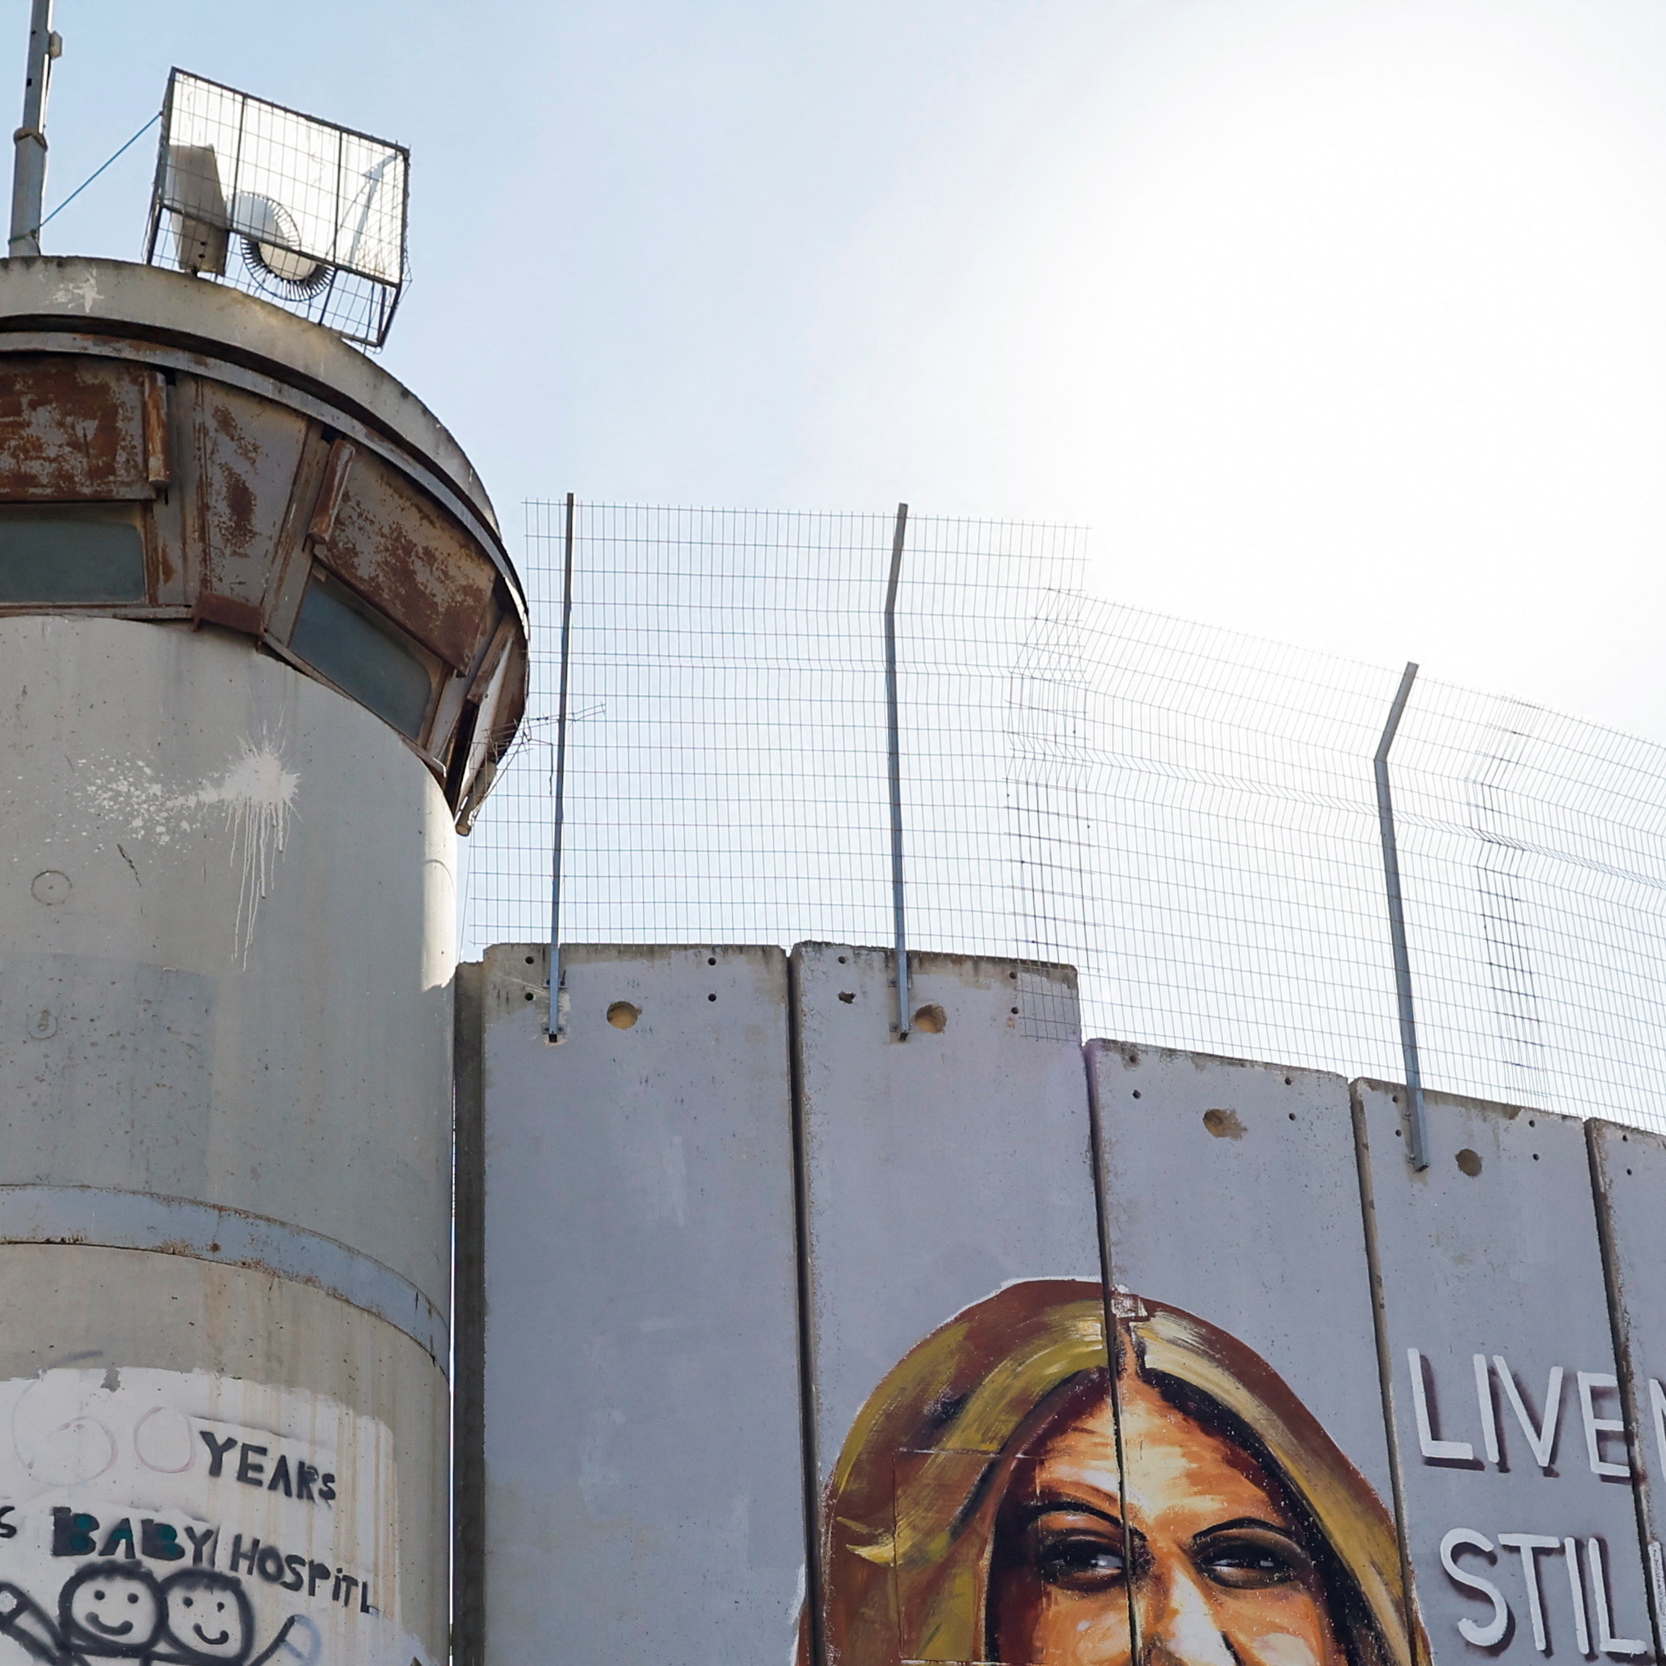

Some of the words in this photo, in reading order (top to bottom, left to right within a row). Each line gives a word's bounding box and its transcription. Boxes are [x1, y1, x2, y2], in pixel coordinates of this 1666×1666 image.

[1407, 1347, 1632, 1479] LIVE
[198, 1427, 337, 1503] YEARS
[50, 1504, 218, 1565] BABY
